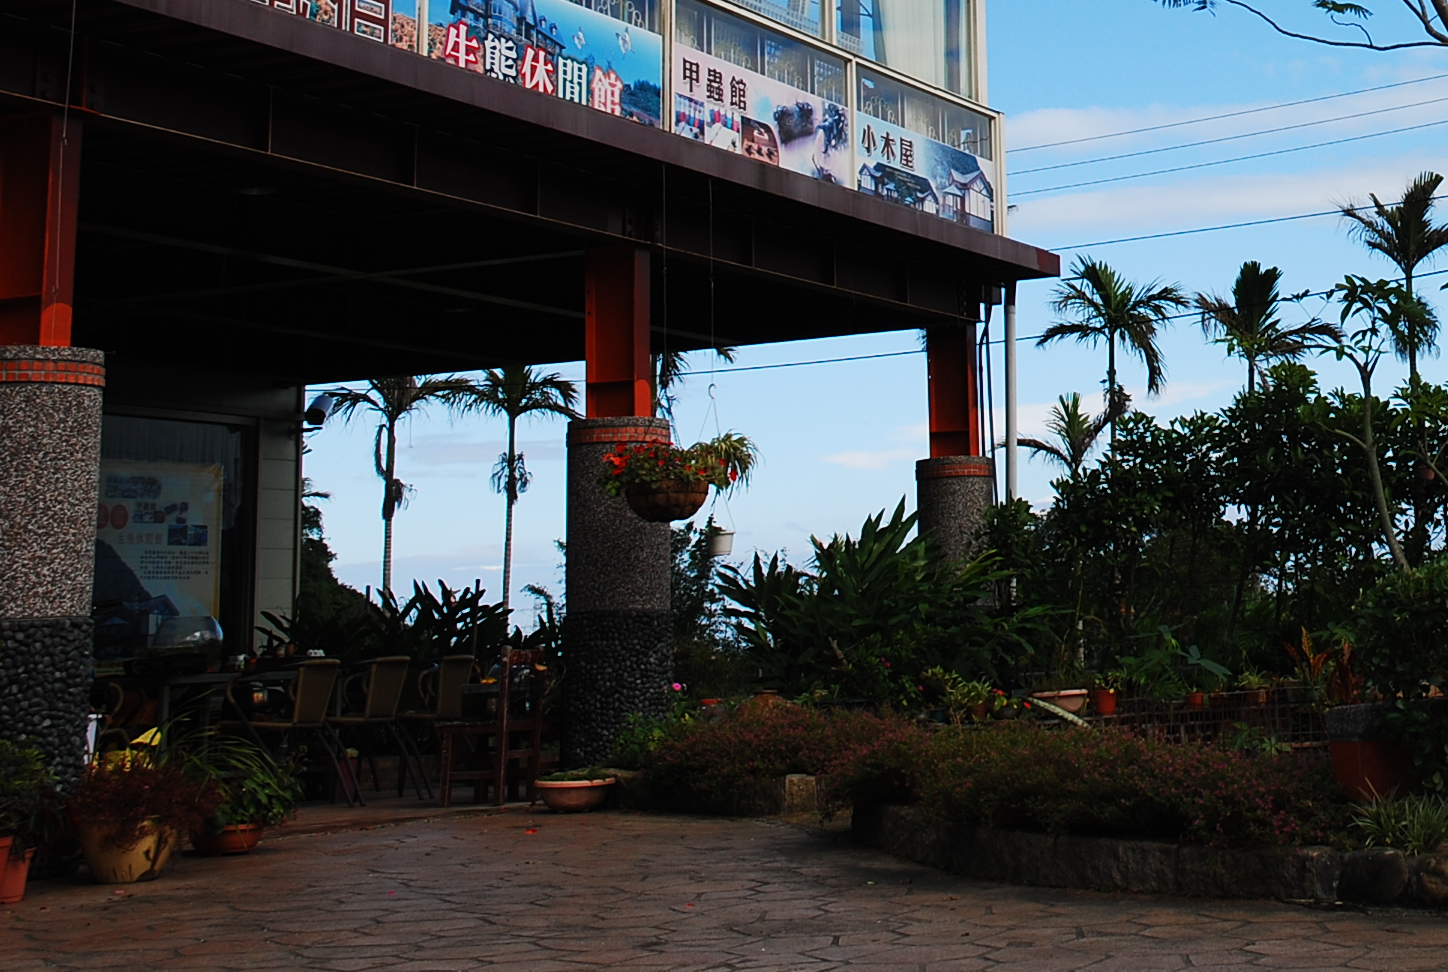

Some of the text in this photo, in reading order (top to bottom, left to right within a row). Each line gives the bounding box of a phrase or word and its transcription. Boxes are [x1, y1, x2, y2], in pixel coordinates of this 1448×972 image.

[682, 57, 748, 111] 甲蟲館
[861, 123, 915, 170] 小木屋
